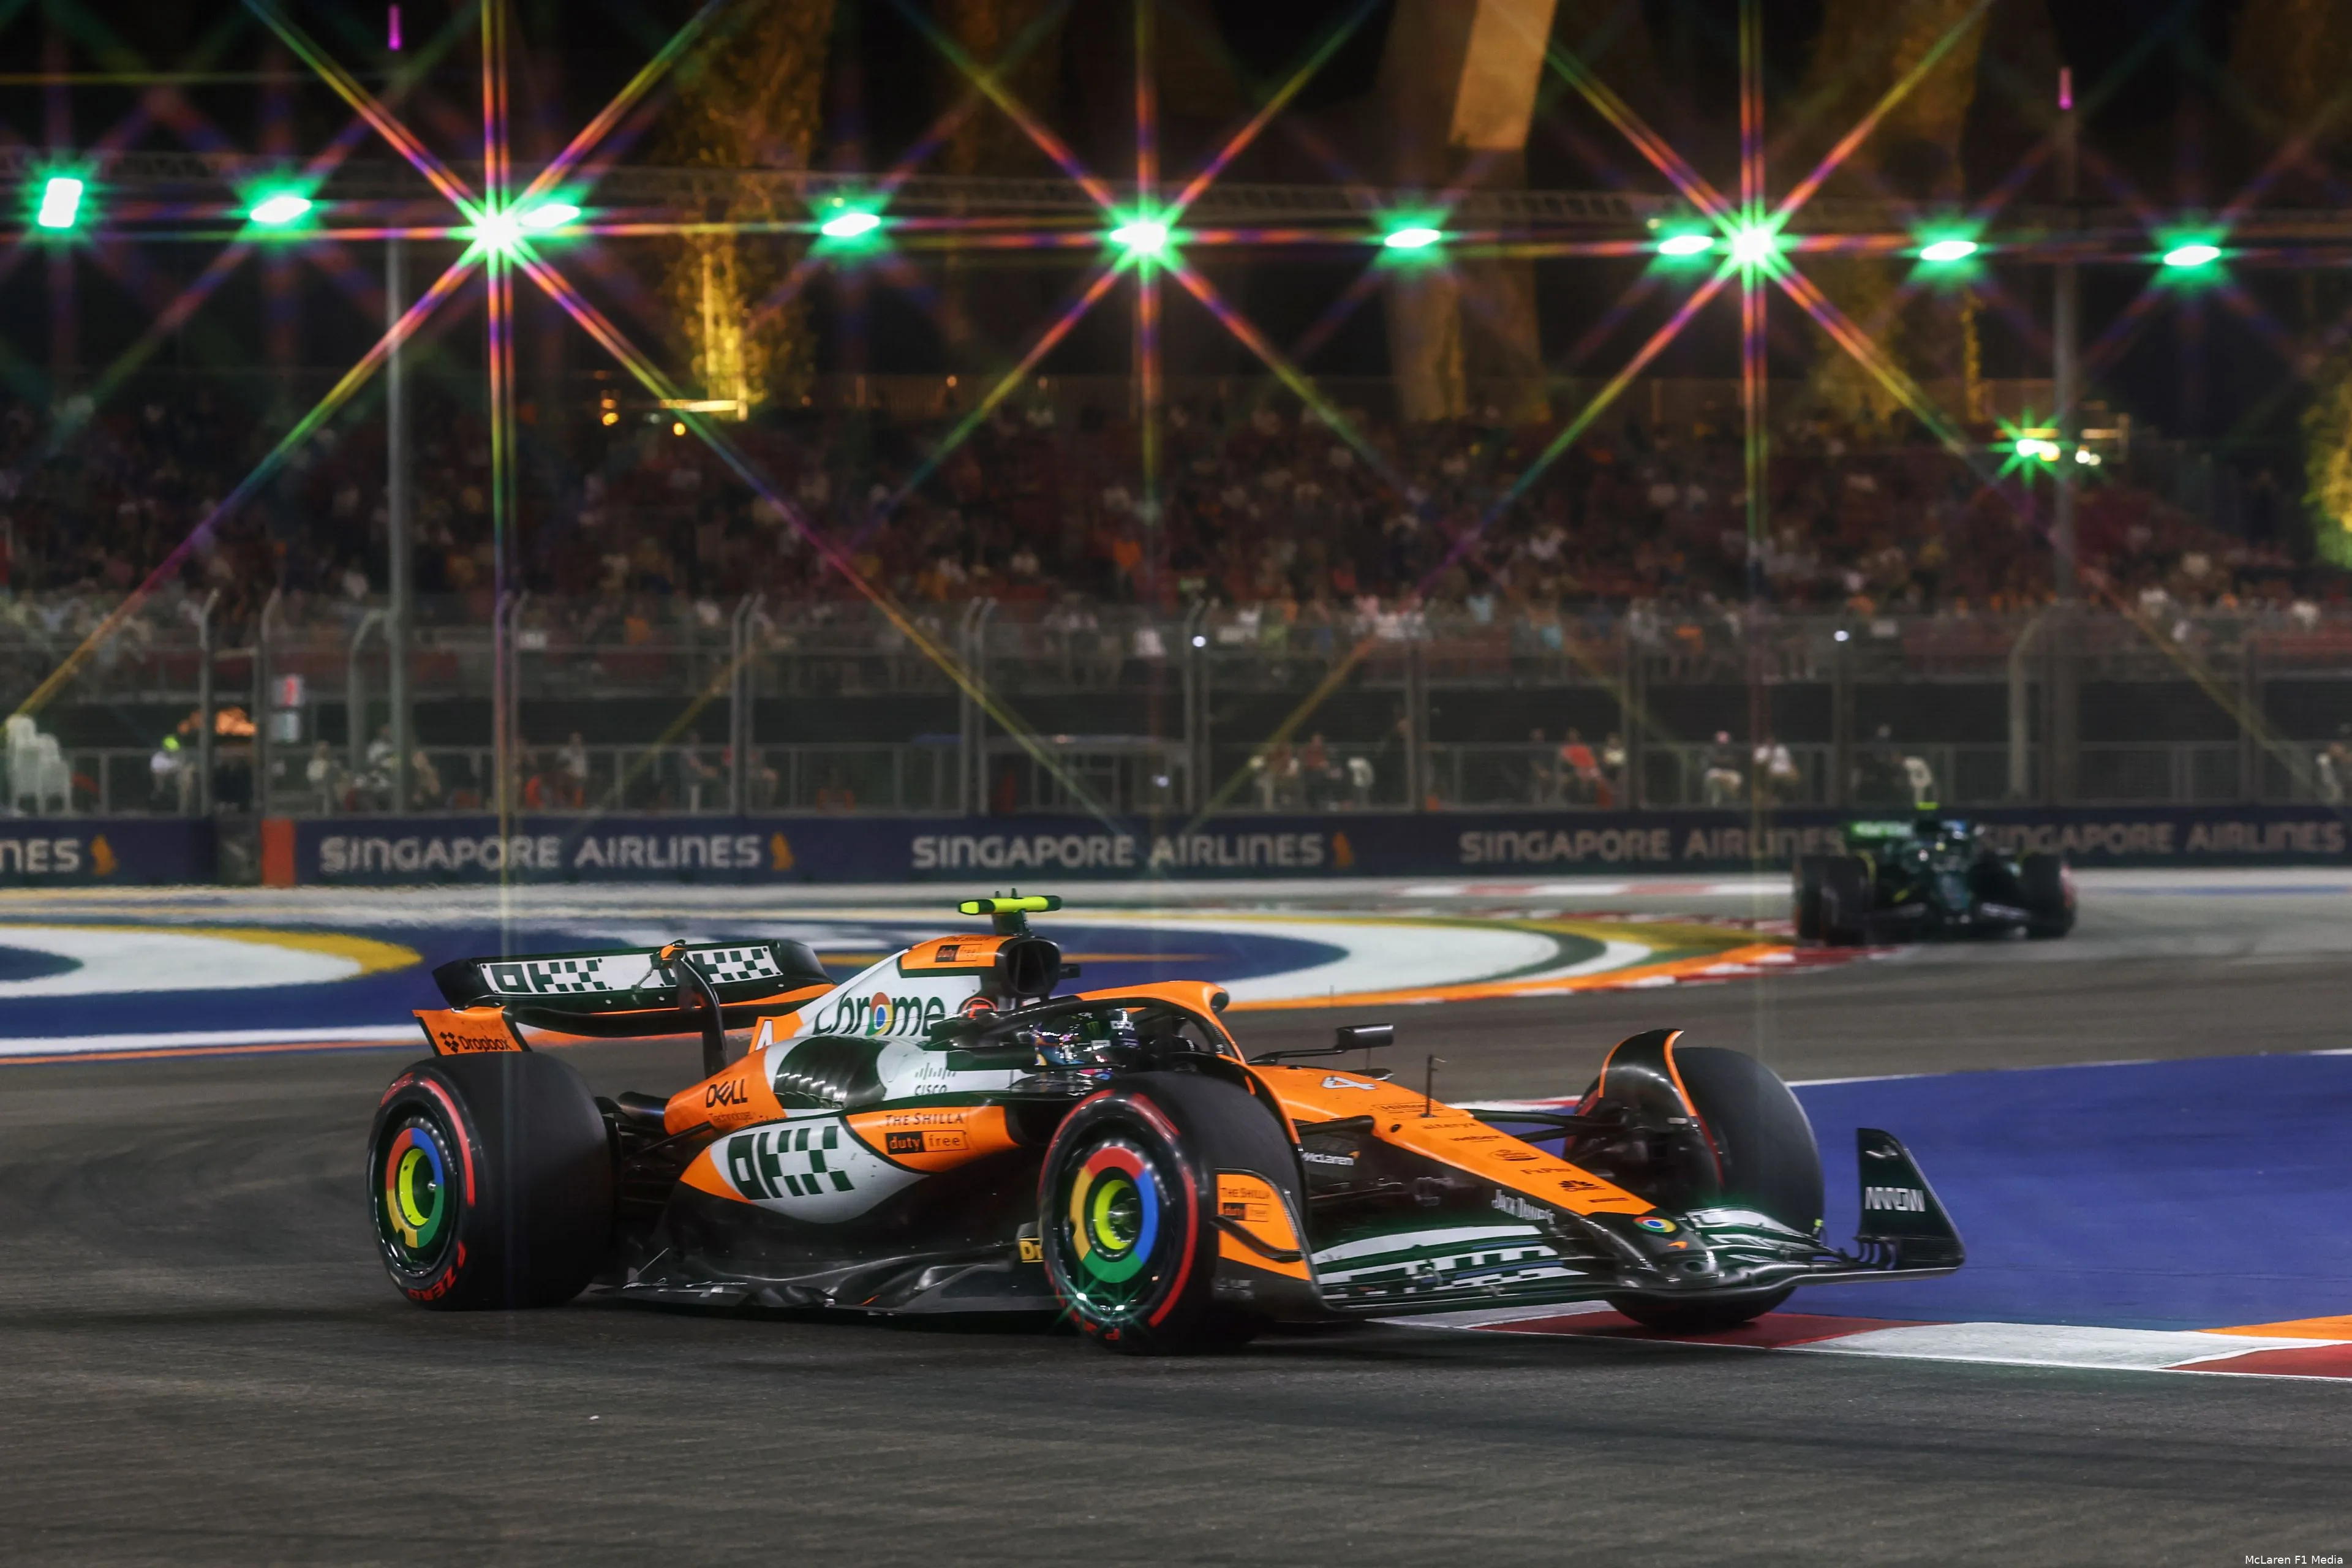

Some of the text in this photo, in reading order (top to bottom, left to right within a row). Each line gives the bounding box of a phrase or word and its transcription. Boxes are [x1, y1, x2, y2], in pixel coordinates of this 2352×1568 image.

[911, 833, 1325, 869] SINGAPORE AIRLINES
[1458, 828, 1672, 864] SINGAPORE
[2186, 821, 2345, 854] AIRLINES
[319, 834, 763, 873] SINGAPORE AIRLINES
[458, 1035, 513, 1052] Dropbox
[706, 1078, 748, 1108] DELL
[914, 1084, 948, 1096] CISCO
[886, 1113, 964, 1126] THE SHILLA
[889, 1135, 961, 1152] duty free
